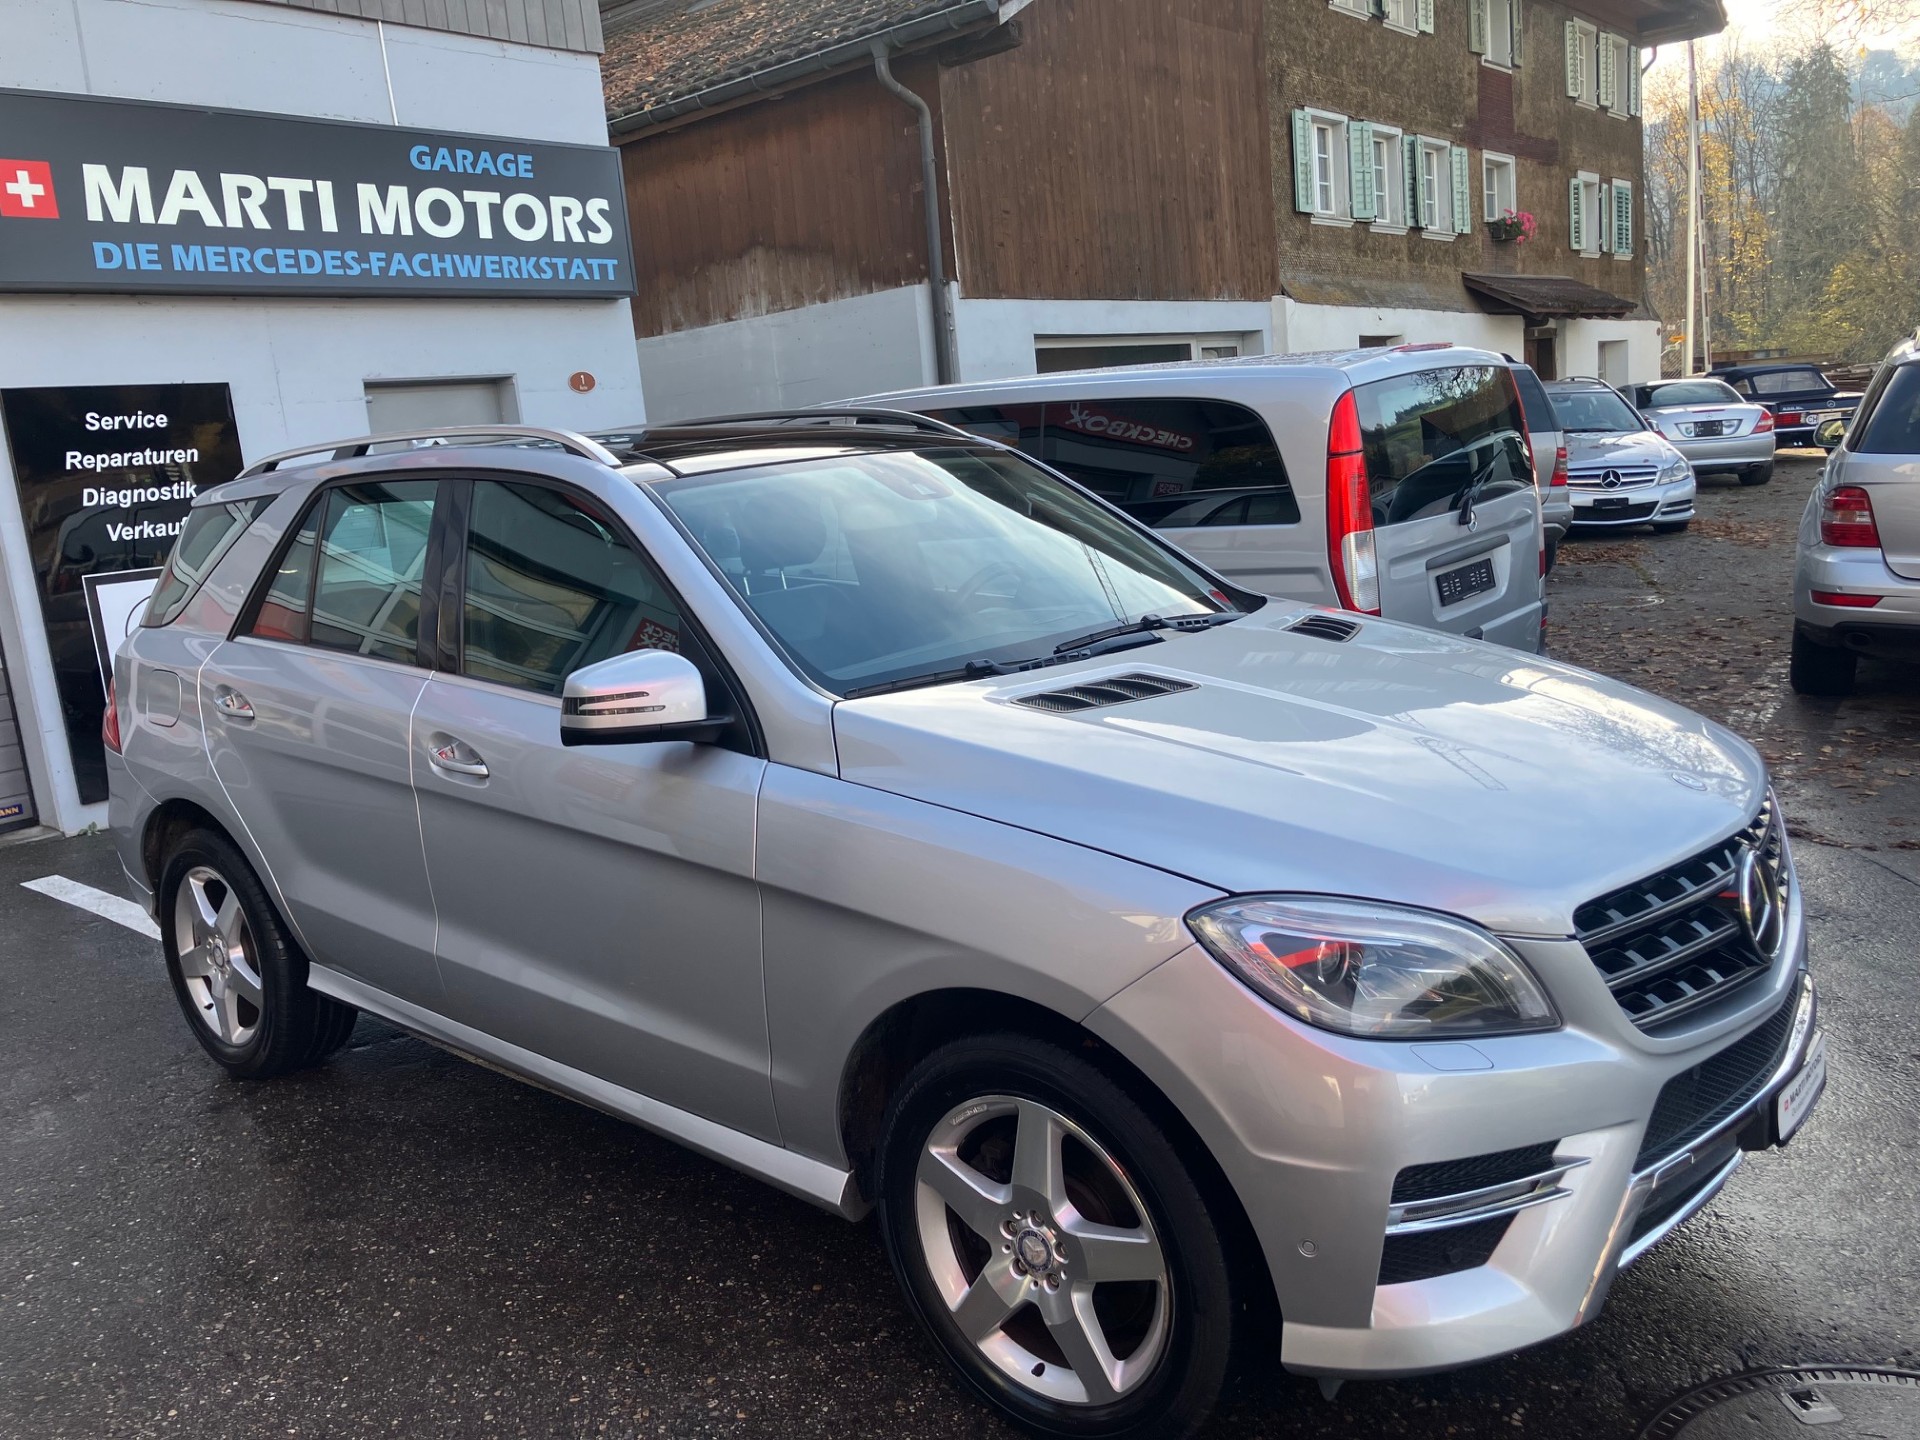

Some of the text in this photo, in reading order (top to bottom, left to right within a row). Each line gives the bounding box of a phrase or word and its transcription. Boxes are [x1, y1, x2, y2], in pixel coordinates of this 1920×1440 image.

[410, 145, 534, 178] GARAGE
[82, 163, 613, 244] MARTI MOTORS
[92, 241, 618, 281] DIE MERCEDES-FACHWERKSTATT
[85, 411, 168, 430] Service
[65, 448, 198, 472] Reparaturen
[82, 481, 198, 508] Diagnostik
